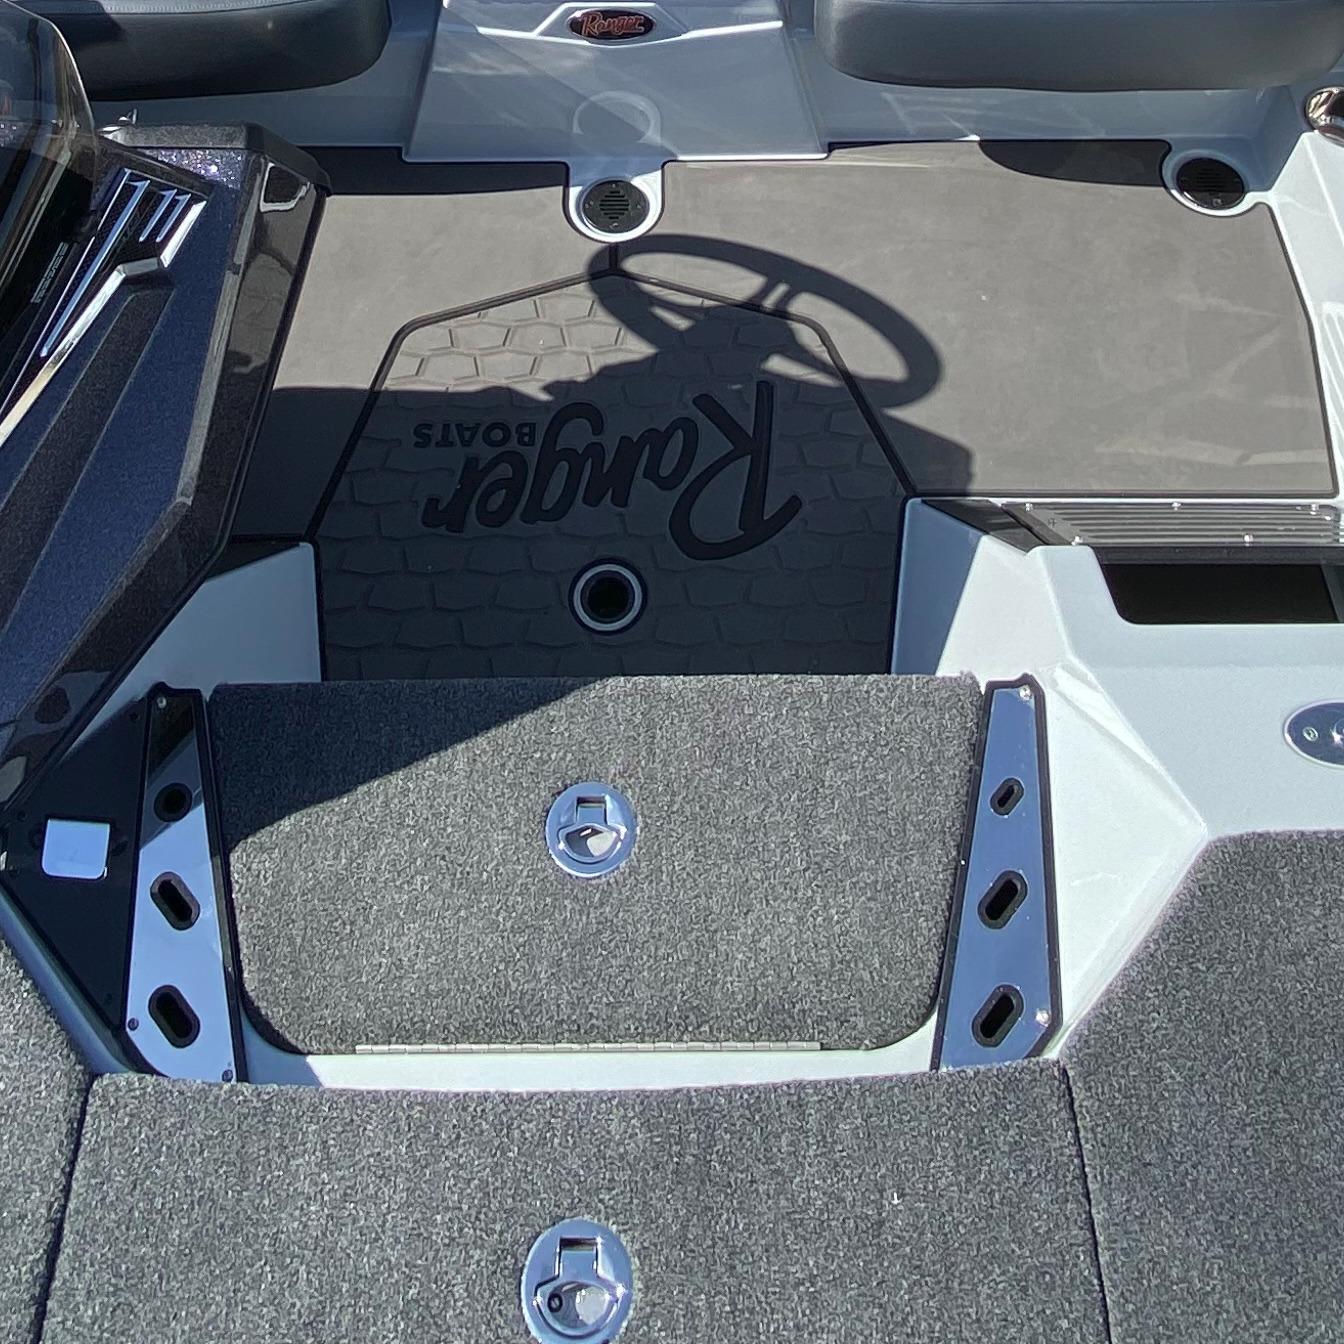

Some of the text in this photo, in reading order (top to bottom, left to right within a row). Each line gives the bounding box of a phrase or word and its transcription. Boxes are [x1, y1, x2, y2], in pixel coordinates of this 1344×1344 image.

[580, 11, 645, 36] Ranger
[412, 421, 537, 449] BOATS
[421, 380, 803, 561] Ranger
